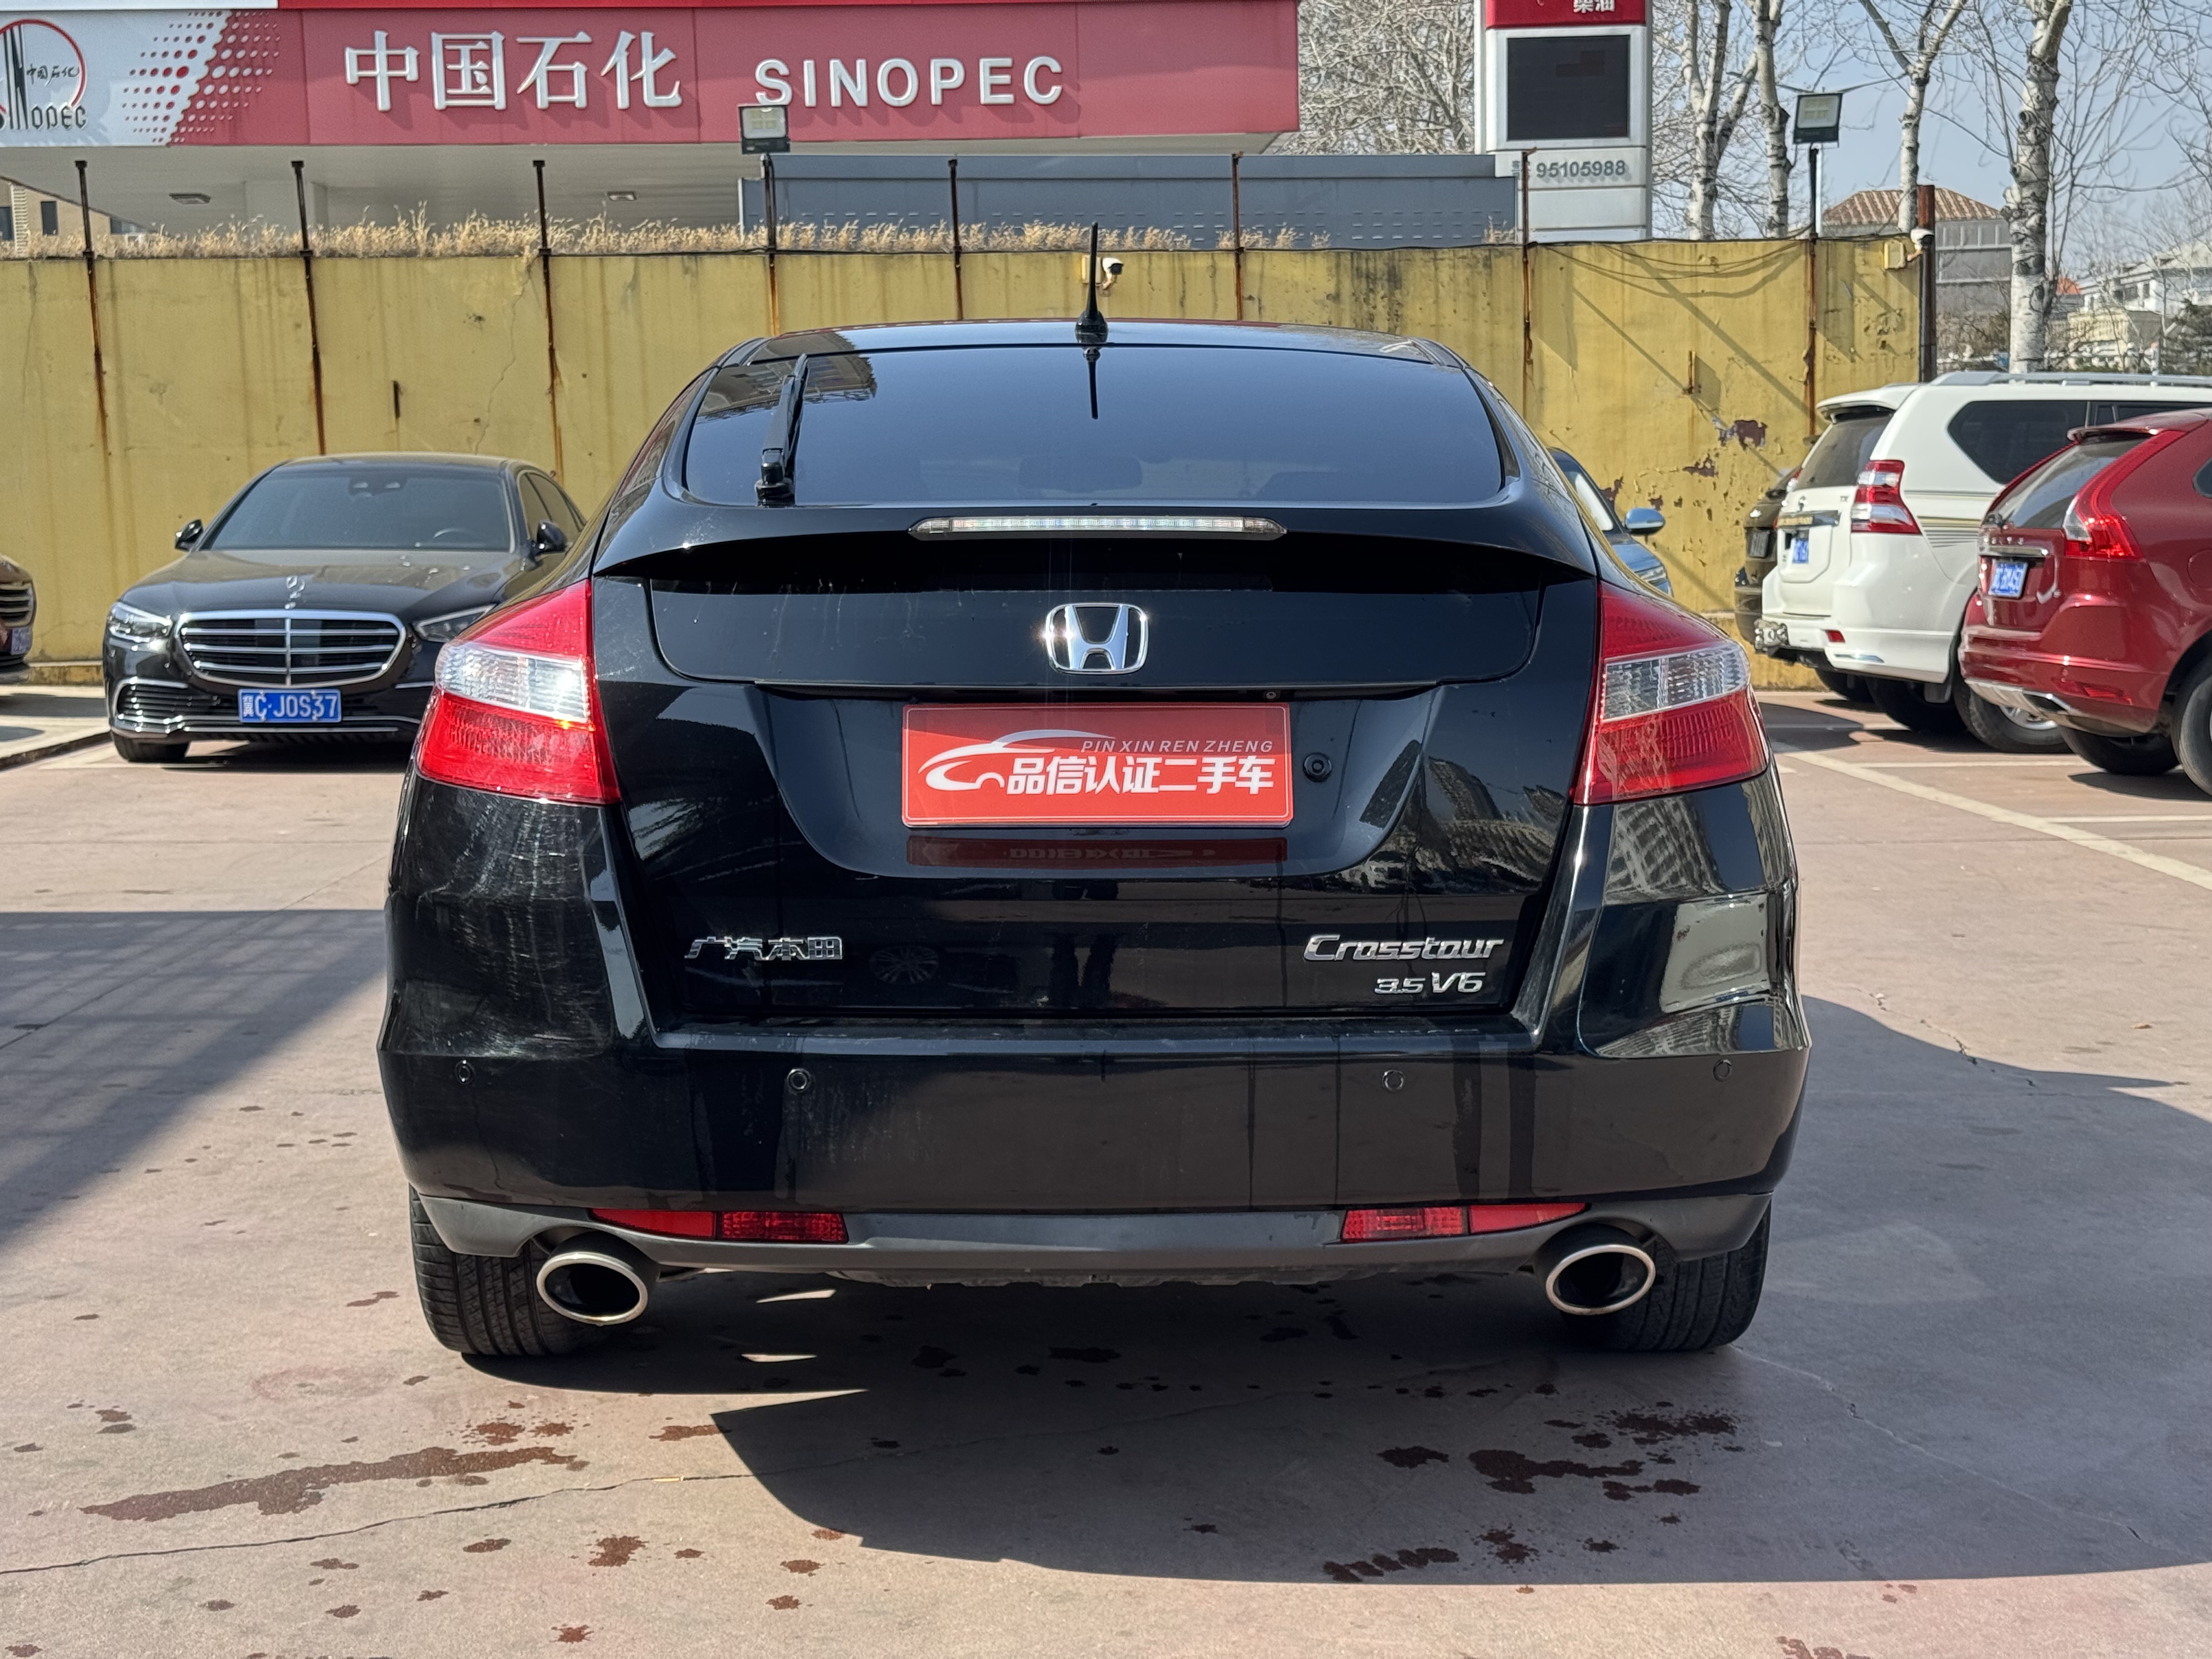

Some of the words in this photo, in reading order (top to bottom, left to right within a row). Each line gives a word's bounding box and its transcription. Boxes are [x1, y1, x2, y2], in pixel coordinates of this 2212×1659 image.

[345, 30, 682, 111] 中国石化
[755, 56, 1062, 108] SINOPEC
[1536, 160, 1626, 178] 95105988
[1081, 741, 1115, 753] PIN
[1119, 741, 1154, 753] XIN
[1159, 741, 1201, 753] REN
[1203, 741, 1274, 753] ZHENG
[1006, 755, 1276, 795] 品信认证二手车
[684, 936, 843, 961] 广汽本田
[1304, 934, 1504, 961] Crosstour
[1431, 972, 1486, 994] V6
